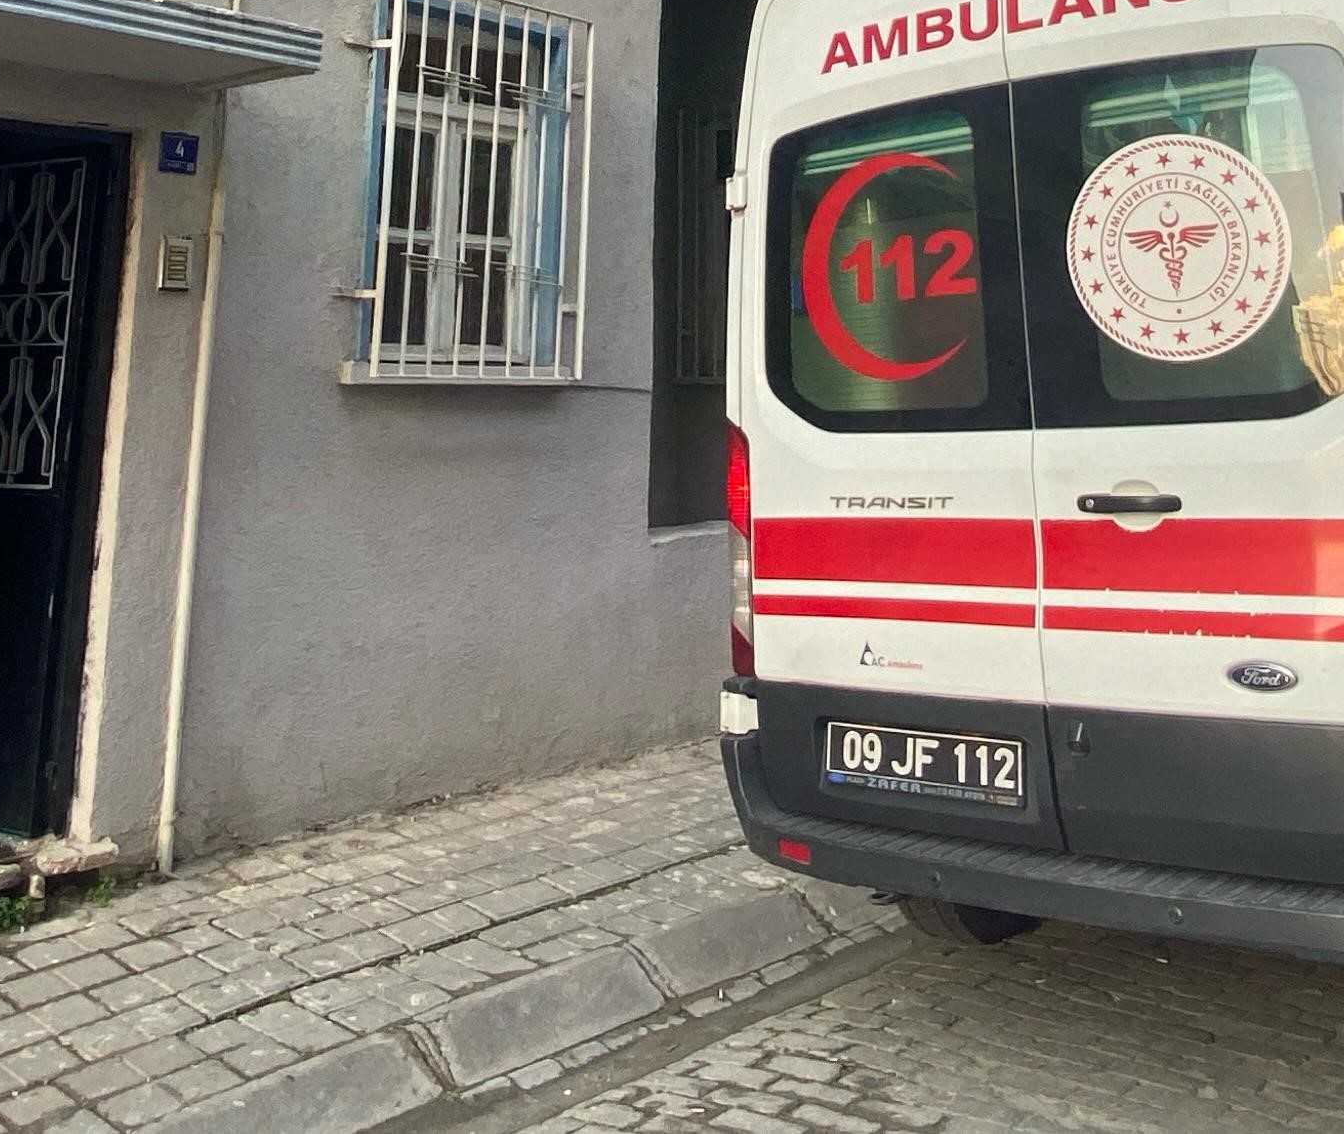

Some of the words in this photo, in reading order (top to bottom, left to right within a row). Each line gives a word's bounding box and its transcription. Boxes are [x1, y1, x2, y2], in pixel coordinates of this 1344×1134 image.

[174, 139, 185, 158] 4
[1106, 177, 1178, 247] CUMHURİYETİ
[1184, 179, 1233, 218] SAĞLIK
[839, 229, 977, 305] 112
[1107, 254, 1147, 308] TÜRKİYE
[1209, 220, 1242, 302] BAKANLIĞI
[829, 495, 954, 510] TRANSIT
[1240, 666, 1282, 687] Ford
[842, 729, 883, 773] 09
[891, 737, 940, 778] JF
[953, 742, 1016, 790] 112
[867, 777, 921, 794] ZAFER
